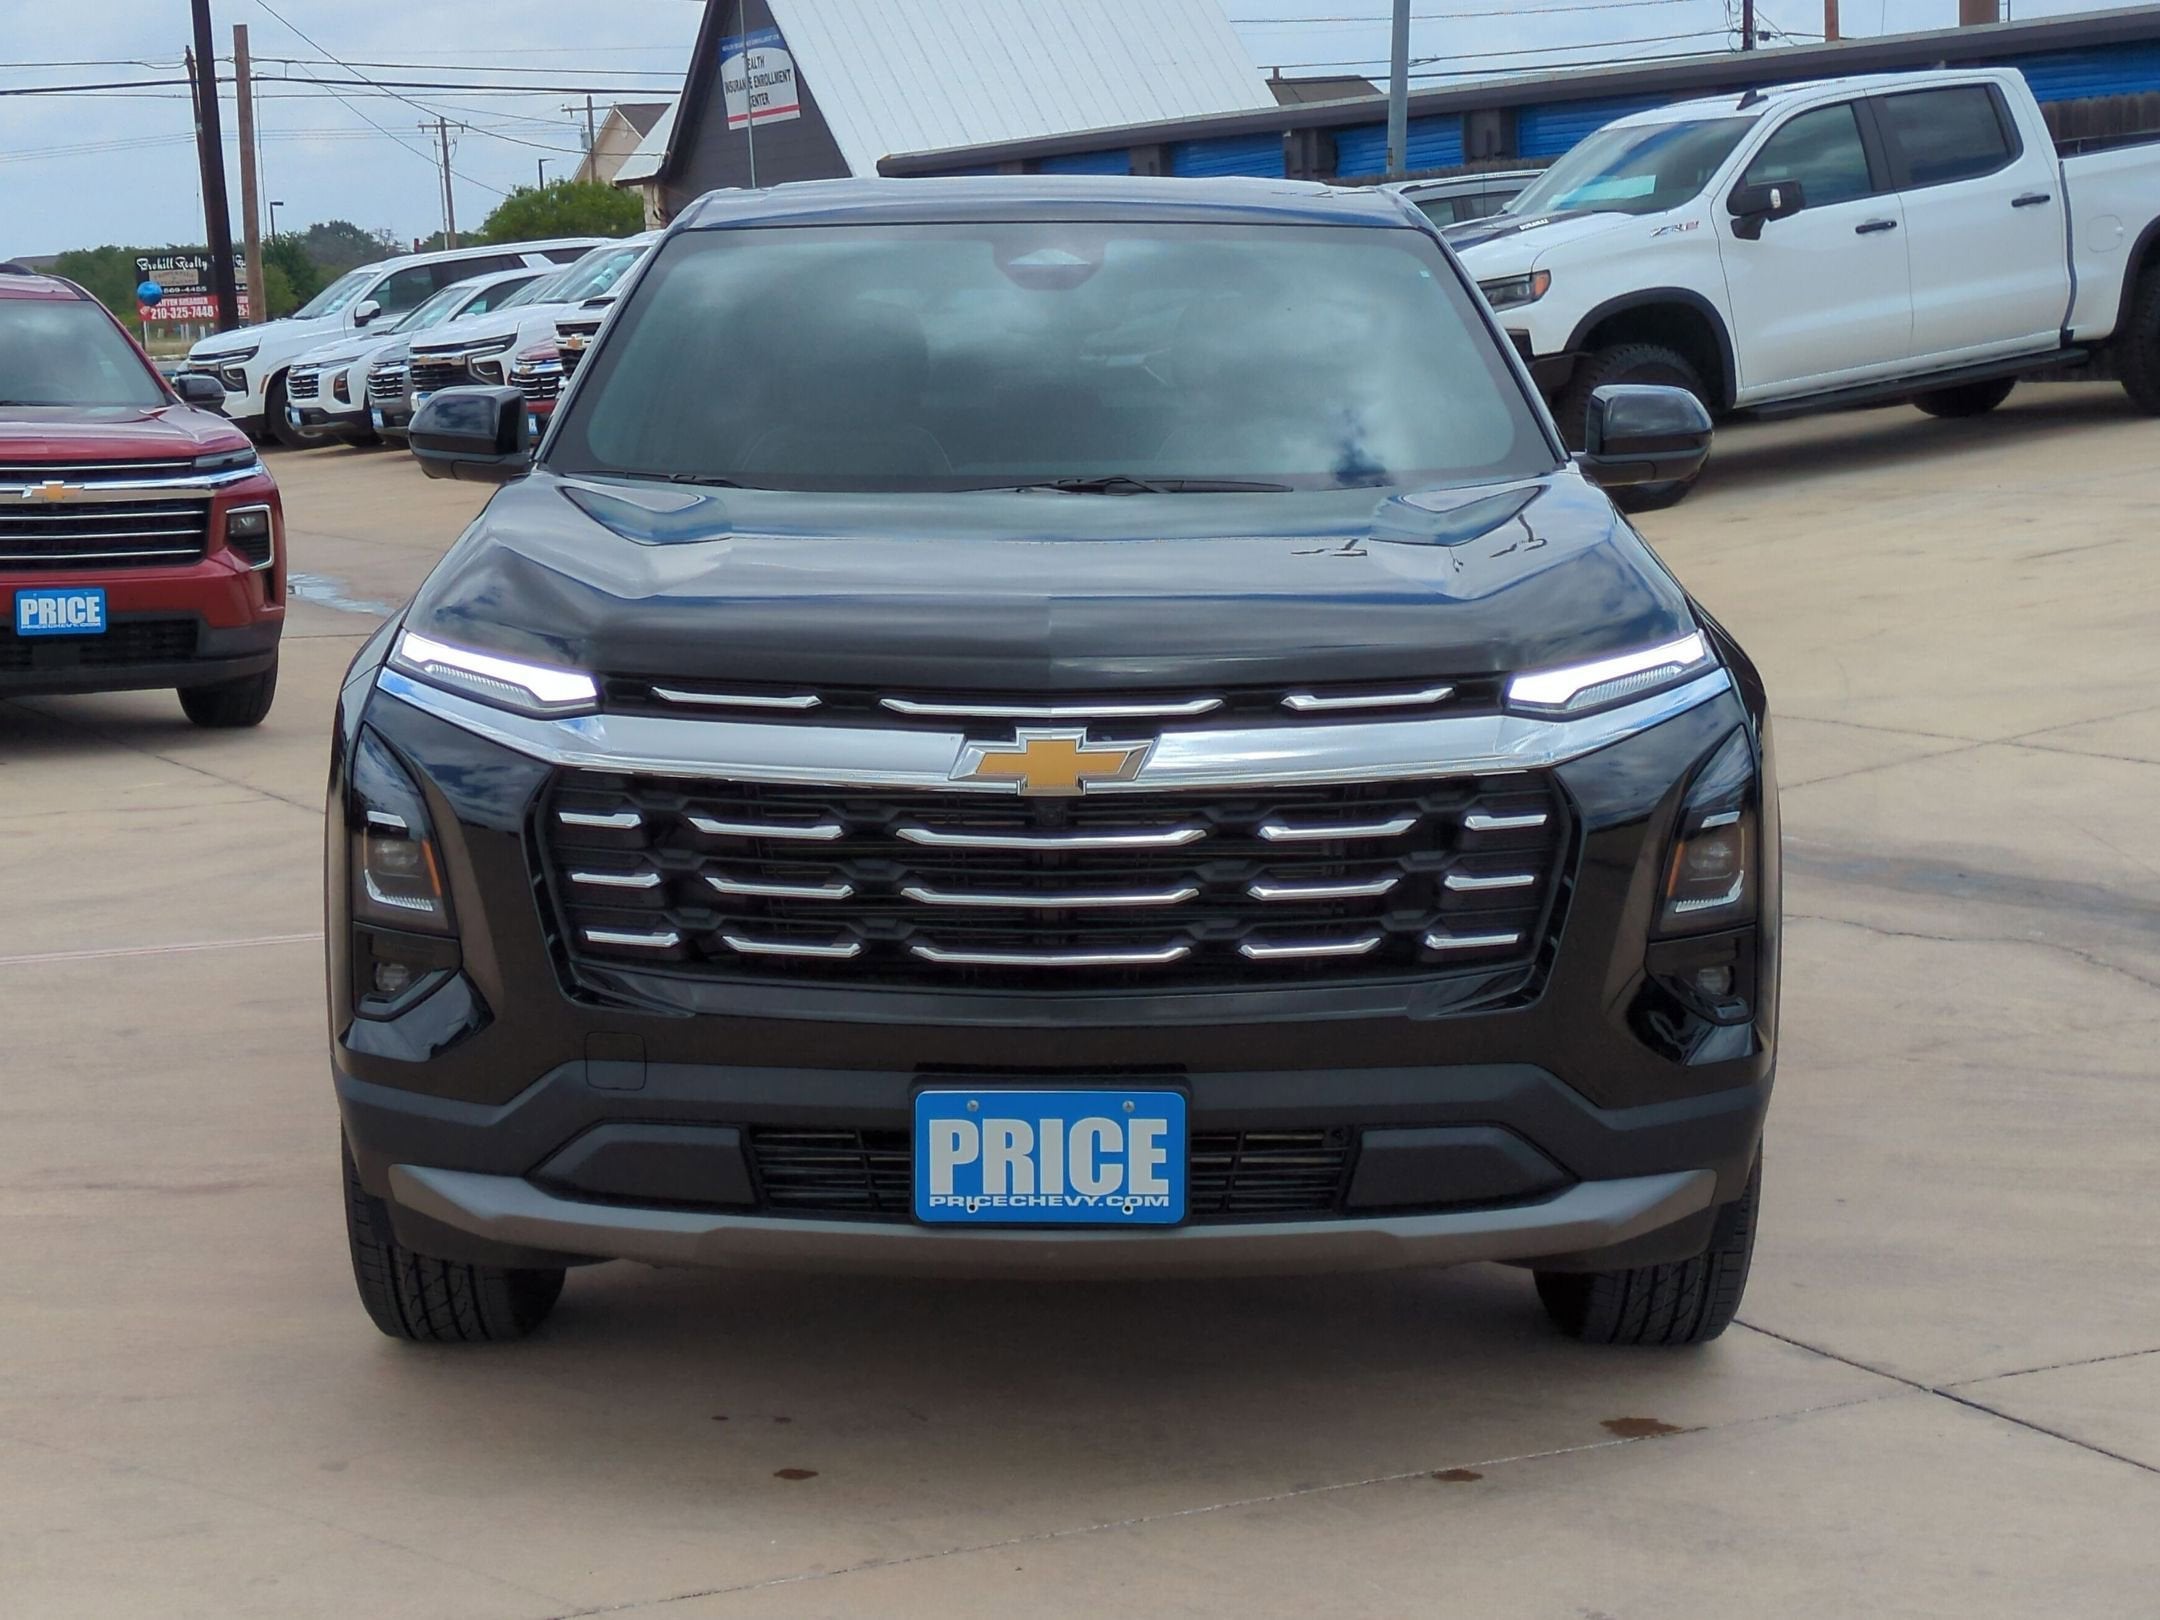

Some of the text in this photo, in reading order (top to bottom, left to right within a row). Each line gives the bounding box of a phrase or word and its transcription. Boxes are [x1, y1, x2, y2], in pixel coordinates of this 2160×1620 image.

[724, 68, 791, 95] INSURANE ENROLLMENT
[748, 92, 771, 108] ENTER
[174, 256, 208, 272] Realty
[20, 596, 101, 625] PRICE
[929, 1117, 1169, 1196] PRICE
[929, 1195, 1169, 1207] PRICECHEVY.COM
